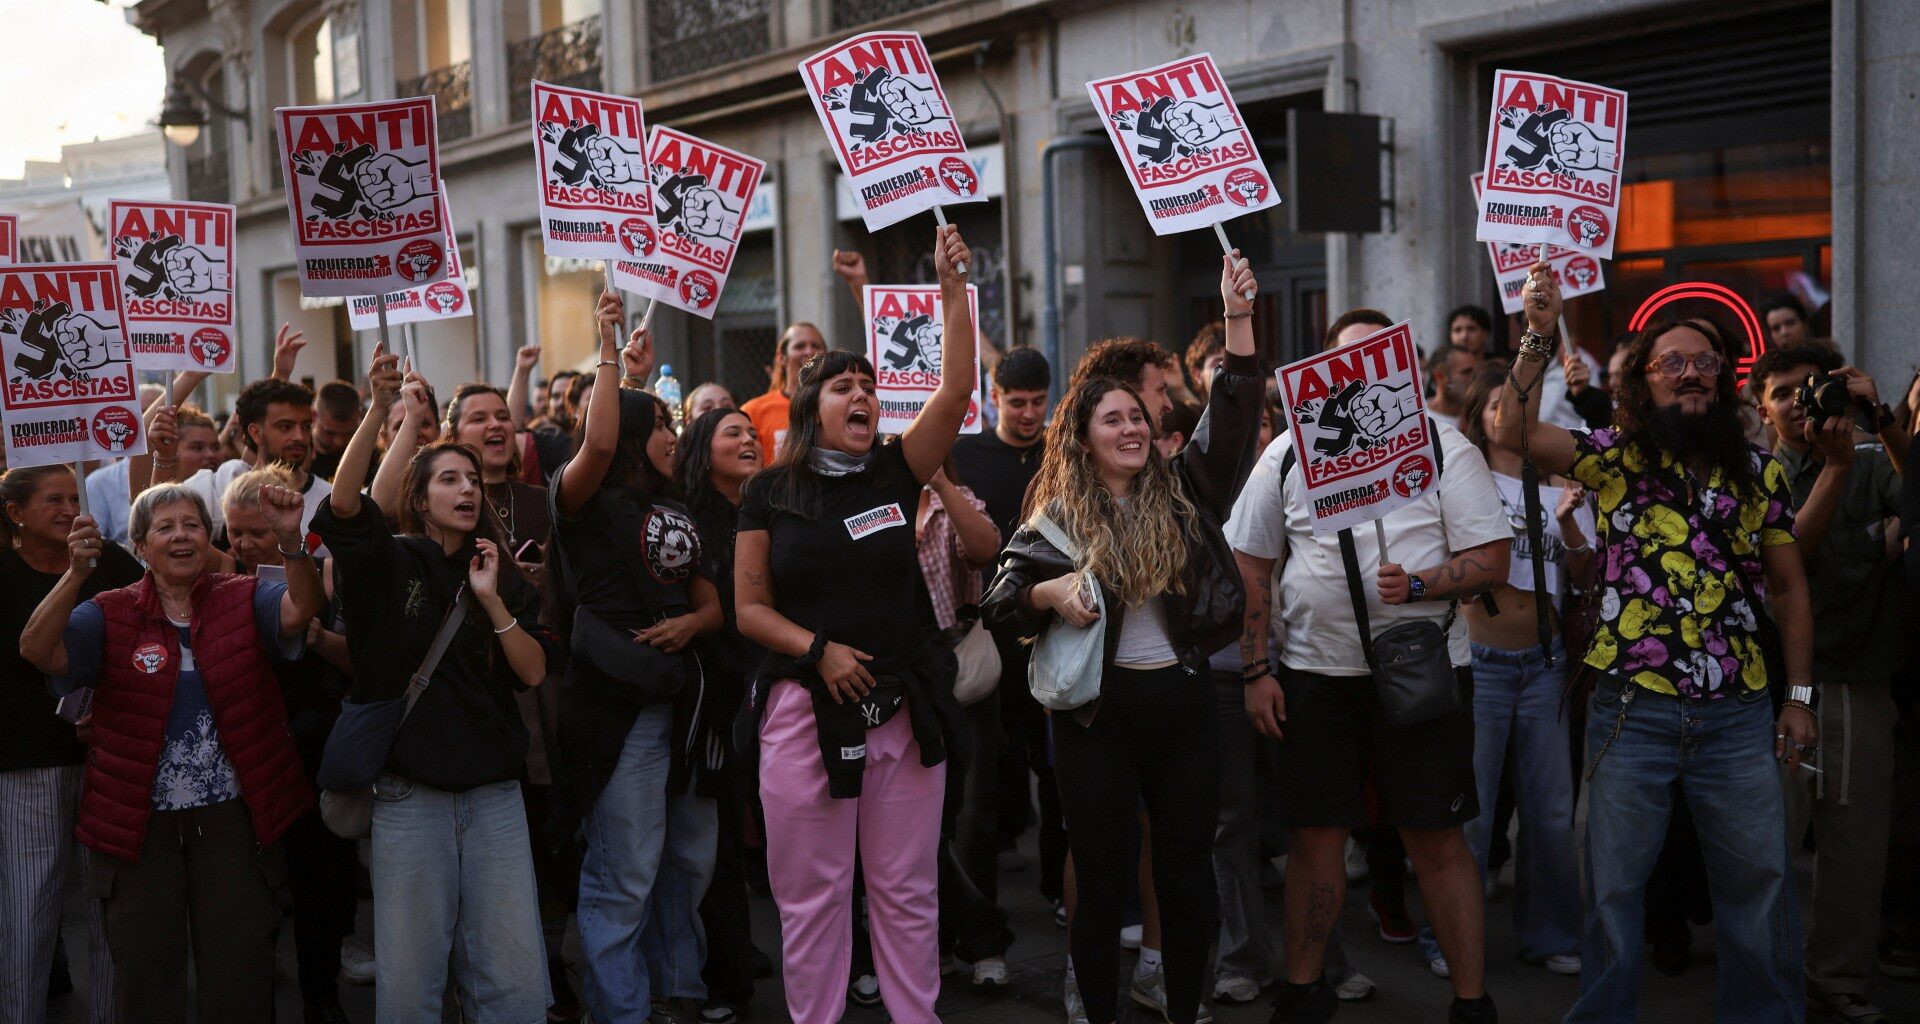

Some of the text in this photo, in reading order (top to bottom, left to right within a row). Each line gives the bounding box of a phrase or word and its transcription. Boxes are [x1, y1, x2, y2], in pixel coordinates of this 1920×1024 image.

[823, 40, 926, 96] ANTI
[1111, 64, 1216, 115] ANTI
[542, 93, 638, 139] ANTI
[1503, 80, 1619, 129] ANTI
[295, 107, 427, 155] ANTI
[850, 131, 957, 168] FASCISTAS
[1138, 141, 1248, 183] FASCISTAS
[653, 140, 756, 200] ANTI
[549, 185, 648, 209] FASCISTAS
[861, 169, 922, 201] IZQUIERDA
[865, 178, 941, 211] REVOLUCIONARIA
[1494, 169, 1610, 199] FASCISTAS
[1149, 188, 1207, 211] IZQUIERDA
[1153, 195, 1225, 220] REVOLUCIONARIA
[1486, 202, 1548, 218] IZQUIERDA
[118, 207, 226, 247] ANTI
[305, 209, 435, 239] FASCISTAS
[549, 218, 601, 234] IZQUIERDA
[1485, 213, 1563, 229] REVOLUCIONARIA
[550, 231, 617, 243] REVOLUCIONARIA
[658, 227, 726, 266] CISTAS
[305, 256, 374, 271] IZQUIERDA
[307, 267, 393, 280] REVOLUCIONARIA
[0, 272, 117, 313] ANTI
[353, 291, 407, 308] IZQURDA
[127, 299, 227, 318] ASCISTAS
[877, 293, 942, 321] AN
[131, 332, 171, 345] UIERDA
[132, 342, 186, 354] LUCIONARIA
[878, 371, 941, 387] FASCIS
[1296, 333, 1409, 405] ANTI
[9, 376, 129, 401] FASCISTAS
[880, 400, 925, 412] ZQUIERDA
[10, 418, 76, 437] IZQUIERDA
[12, 431, 90, 448] REVOLUCIONARIA
[1310, 427, 1423, 482] FASCISTAS
[1314, 484, 1375, 511] IZQUIERDA
[1316, 489, 1391, 520] REVOLUCIONARIA
[847, 507, 891, 529] IZQUIERDA
